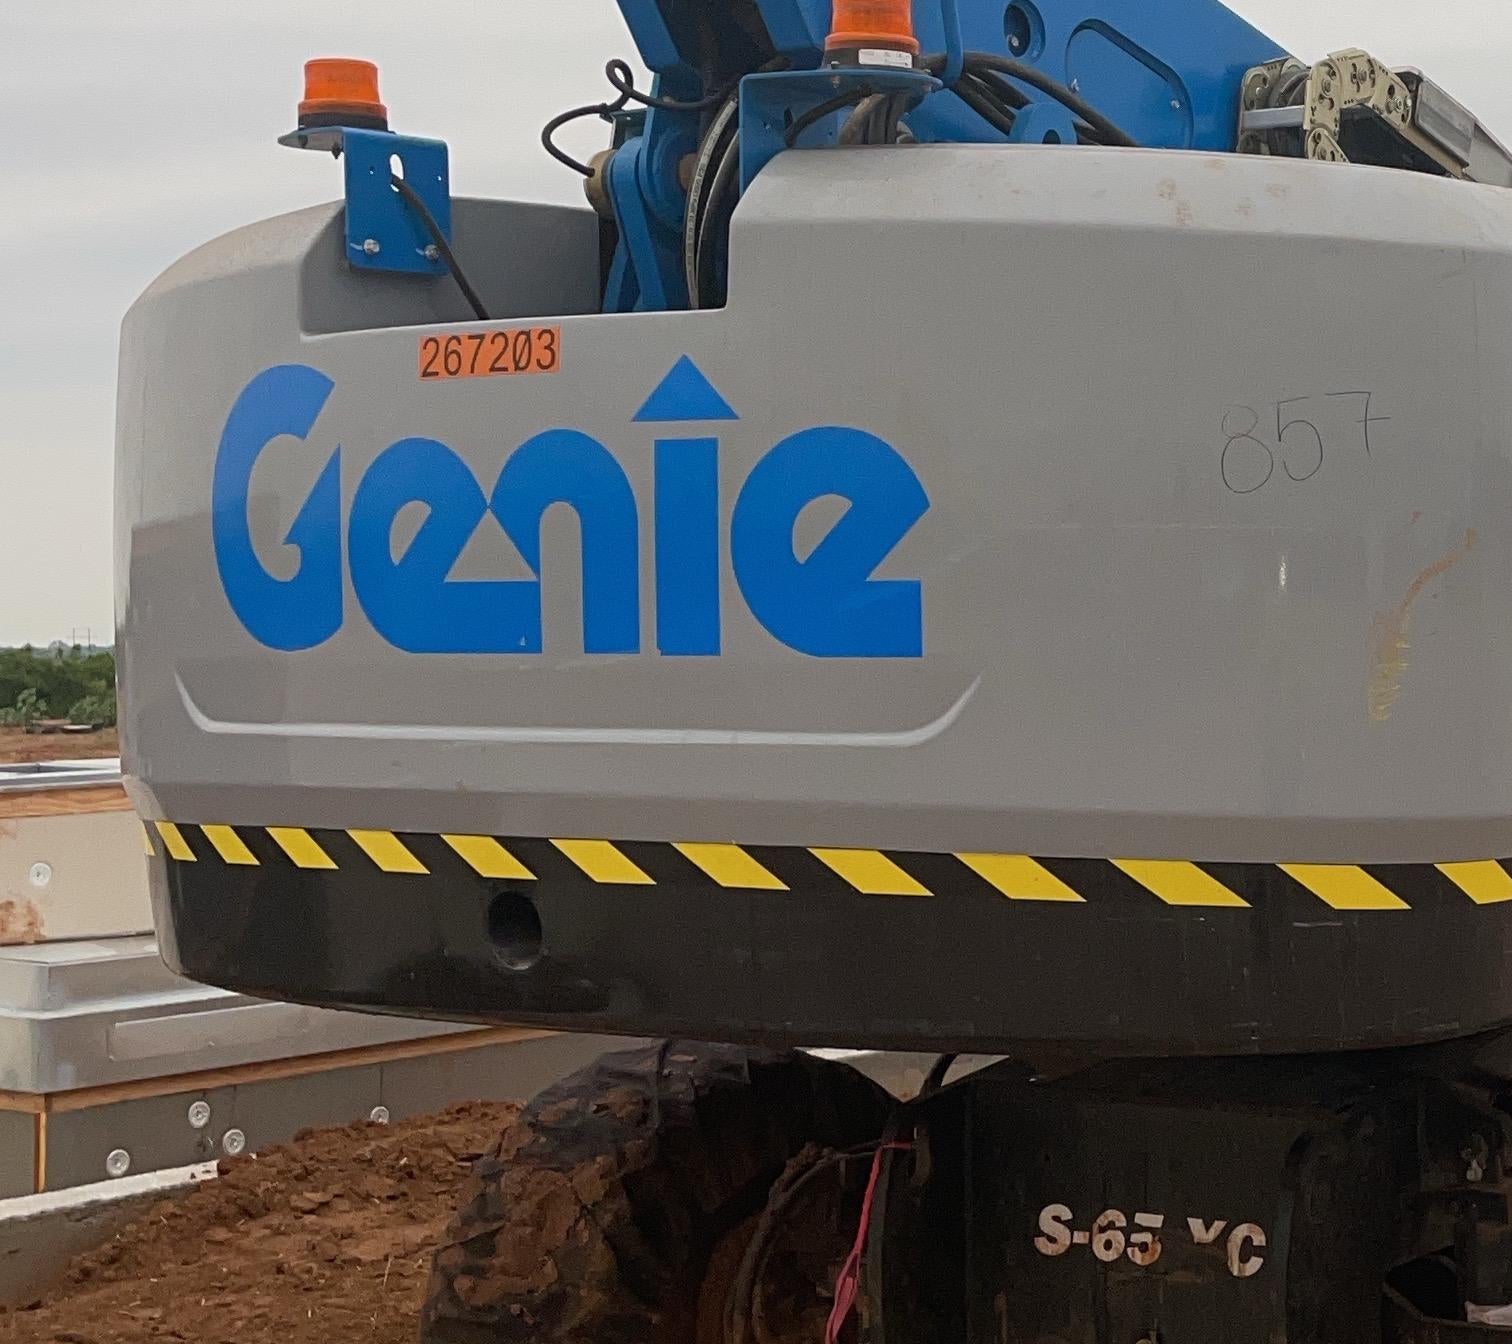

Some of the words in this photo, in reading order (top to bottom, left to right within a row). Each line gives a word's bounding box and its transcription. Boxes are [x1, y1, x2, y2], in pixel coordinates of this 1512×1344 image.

[420, 328, 556, 378] 267203
[1220, 391, 1392, 494] 857
[212, 354, 932, 658] Genie
[1034, 1203, 1164, 1266] S-65
